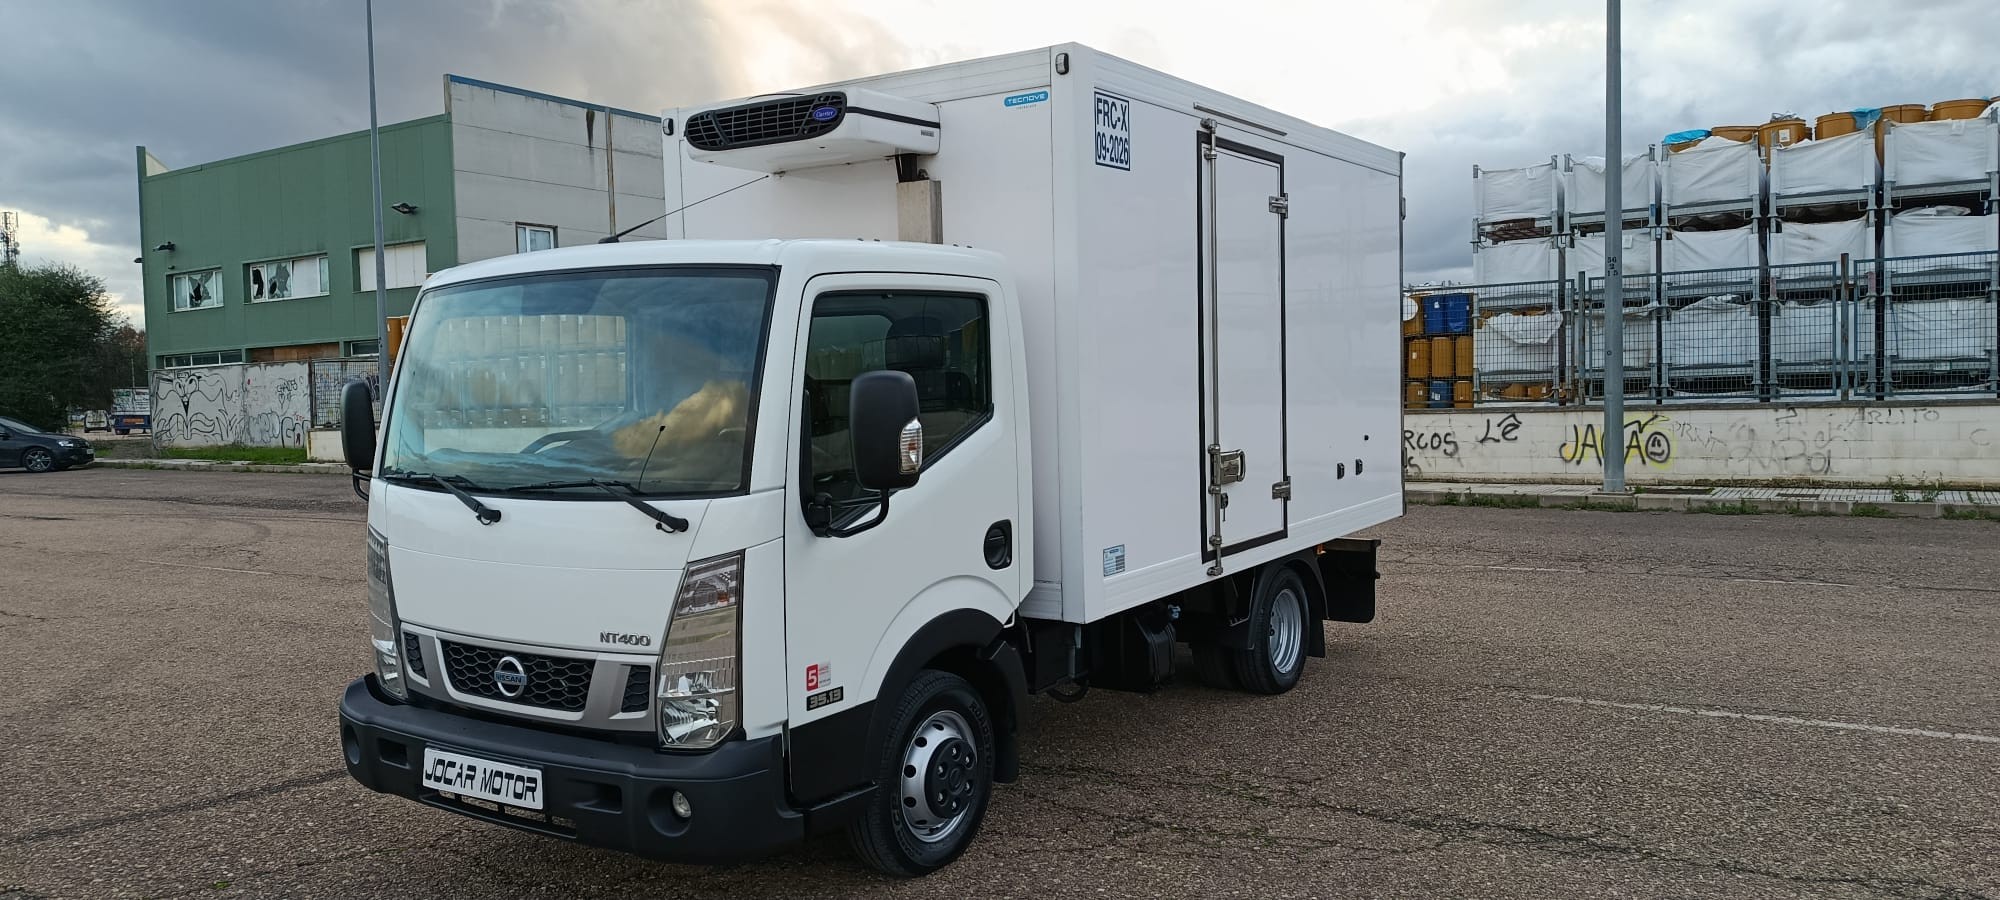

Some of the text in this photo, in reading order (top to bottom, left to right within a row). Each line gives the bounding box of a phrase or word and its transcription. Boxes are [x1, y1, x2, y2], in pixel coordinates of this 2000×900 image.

[1008, 93, 1045, 104] TECNOVE
[1096, 98, 1128, 131] FRC-X
[1096, 132, 1129, 165] 09-2026
[600, 632, 651, 646] NT400
[496, 673, 523, 684] NISSAN
[808, 669, 818, 687] 5
[809, 688, 842, 709] 35.13
[425, 757, 538, 802] JOCAR MOTOR
